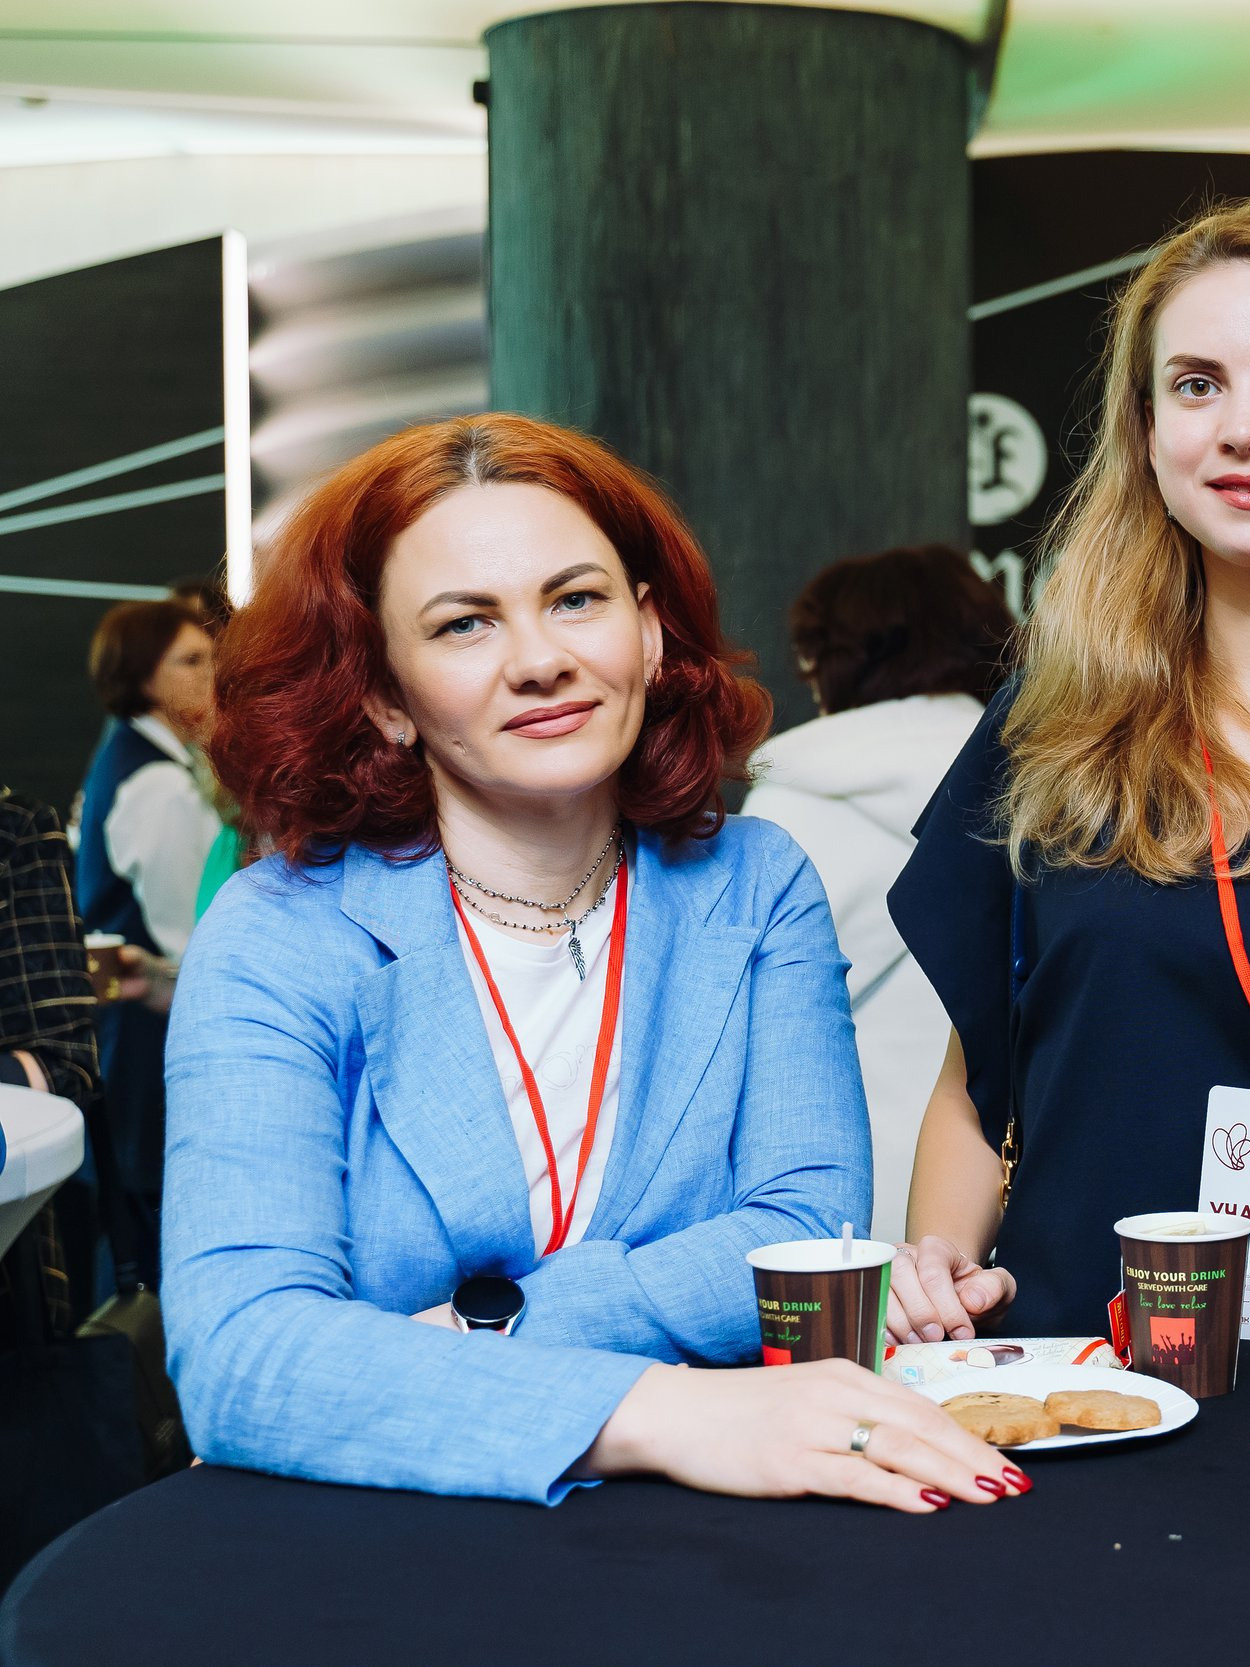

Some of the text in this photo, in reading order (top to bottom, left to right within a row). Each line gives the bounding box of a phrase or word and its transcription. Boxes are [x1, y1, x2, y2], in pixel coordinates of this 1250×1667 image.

[1126, 1266, 1226, 1282] ENJOY YOUR DRINK
[1137, 1282, 1163, 1292] SERVED
[1187, 1283, 1208, 1292] CARE
[783, 1301, 822, 1312] DRINK
[1157, 1295, 1176, 1310] love
[1180, 1295, 1207, 1312] relax
[781, 1314, 801, 1323] CARE
